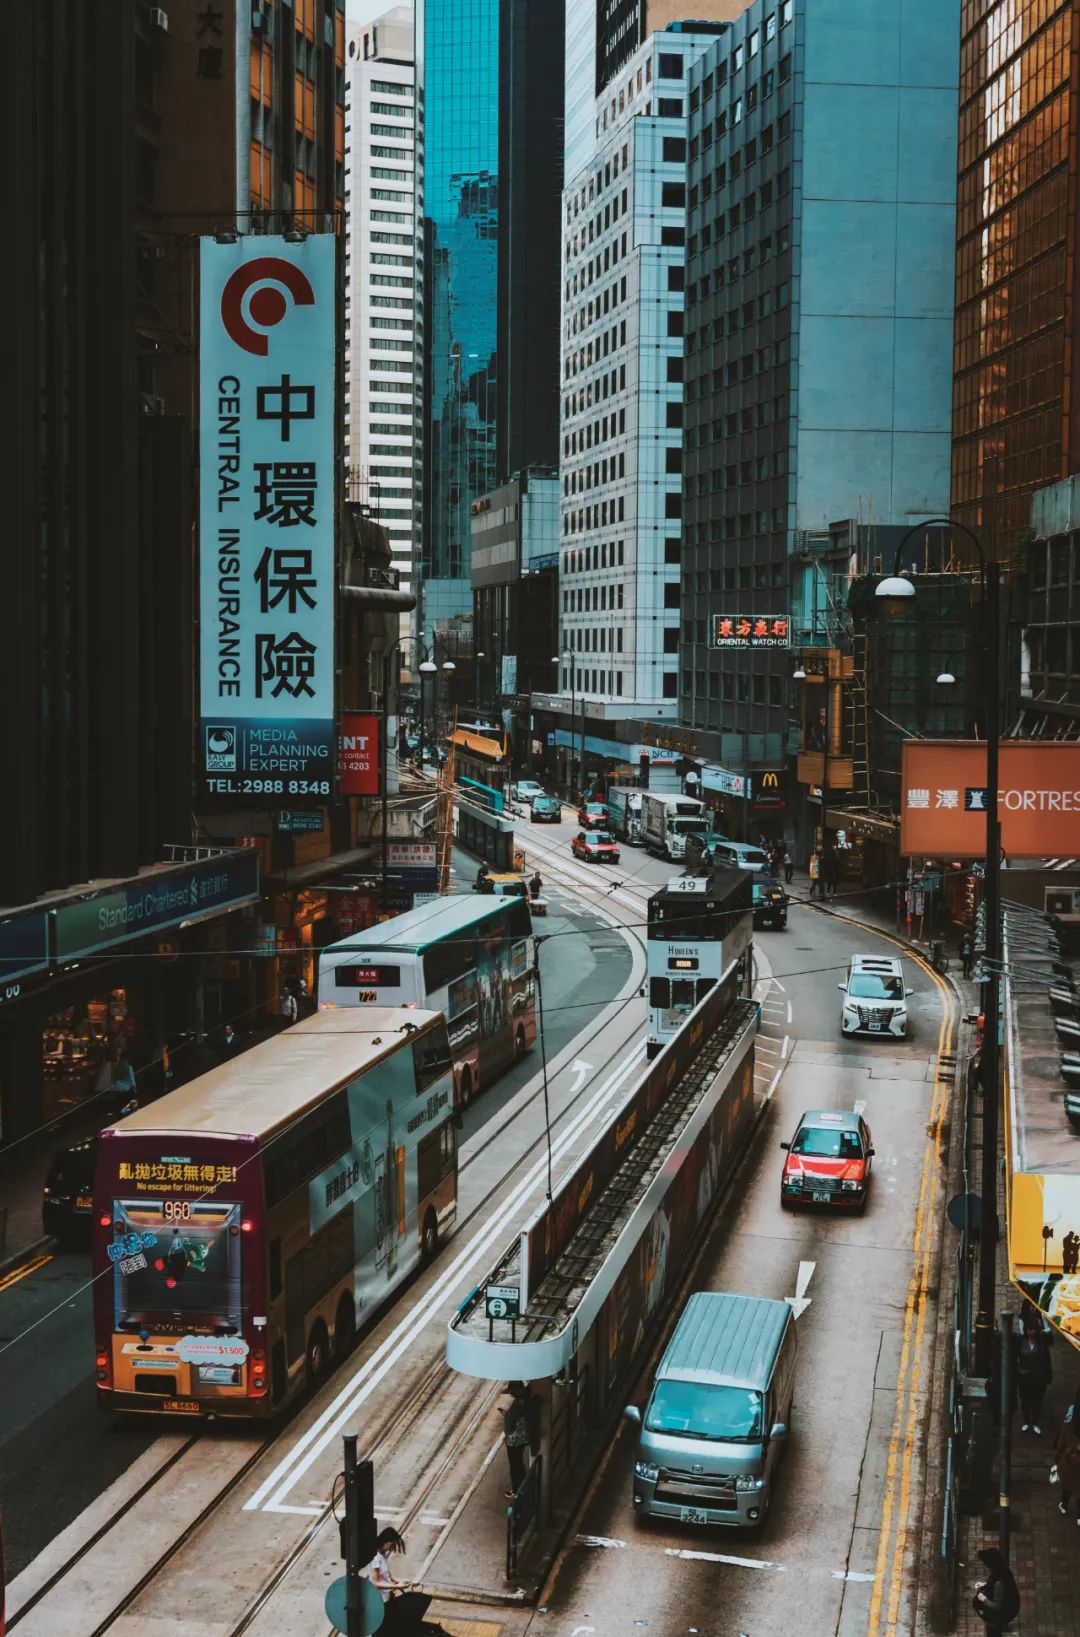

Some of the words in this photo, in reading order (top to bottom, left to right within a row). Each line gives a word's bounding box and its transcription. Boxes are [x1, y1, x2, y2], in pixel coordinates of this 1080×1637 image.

[218, 375, 241, 513] CENTRAL
[253, 374, 318, 698] 中環保險
[218, 528, 241, 697] INSURANCE
[717, 638, 750, 646] ORIENTAL
[751, 638, 777, 646] WATCH
[250, 729, 298, 742] MEDIA
[250, 744, 328, 758] PLANNING
[652, 750, 673, 758] NCB
[250, 760, 308, 772] EXPERT
[348, 762, 370, 771] 4203
[288, 780, 330, 795] 8348
[907, 789, 959, 809] 豐澤
[678, 881, 696, 891] 49
[98, 897, 143, 931] Standard
[144, 886, 190, 917] Chartered
[136, 1182, 147, 1190] No
[148, 1183, 171, 1192] escape
[172, 1183, 183, 1191] for
[164, 1201, 191, 1219] 960
